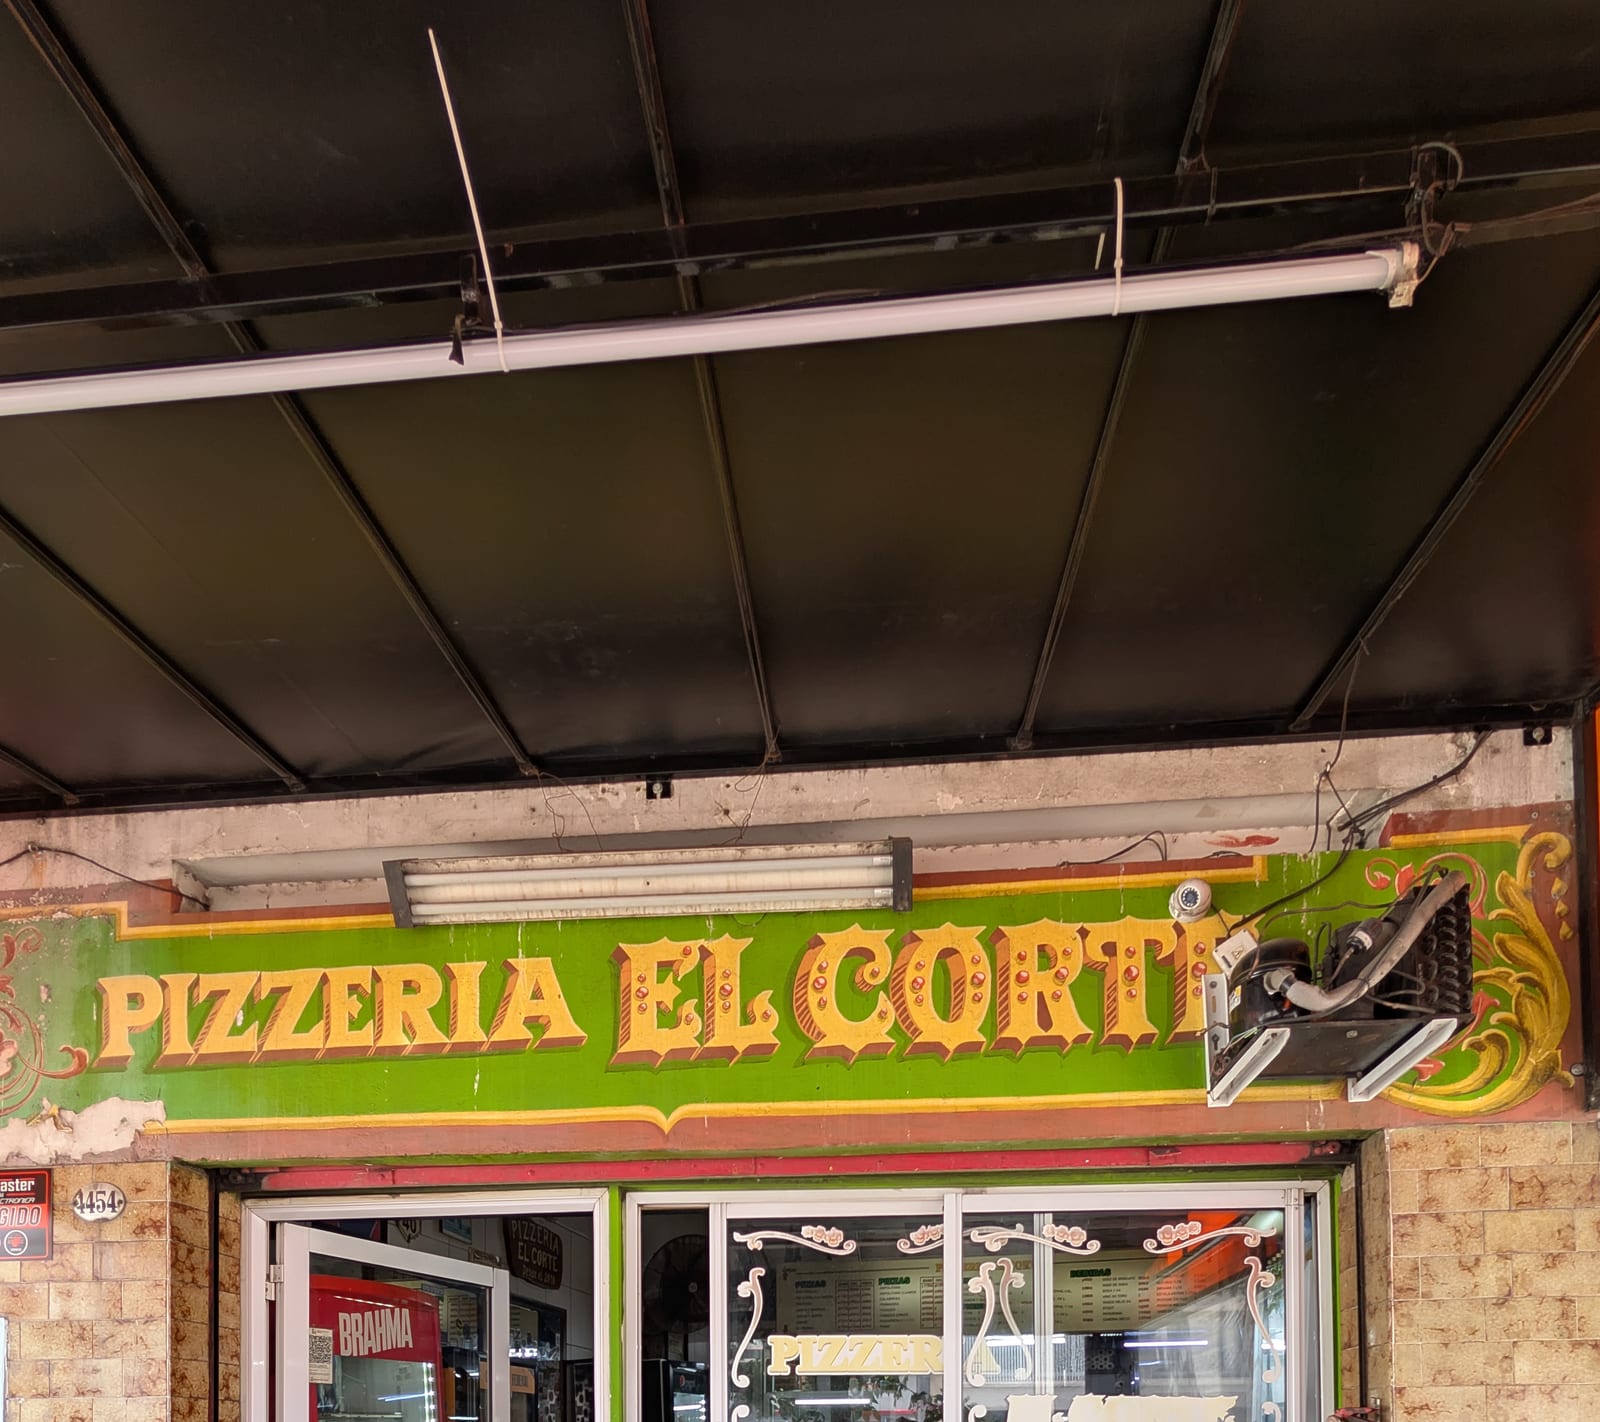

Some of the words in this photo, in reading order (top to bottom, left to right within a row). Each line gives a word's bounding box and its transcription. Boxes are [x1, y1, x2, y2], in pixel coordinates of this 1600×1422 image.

[95, 956, 587, 1068] PIZZERIA
[609, 934, 780, 1067] EL
[0, 1179, 35, 1192] aster
[75, 1188, 118, 1214] 4454
[511, 1220, 560, 1254] PIZZERIA
[518, 1241, 530, 1263] EL
[531, 1247, 559, 1273] CORTE
[338, 1307, 414, 1357] BRAHMA
[767, 1334, 1001, 1375] PIZZERA
